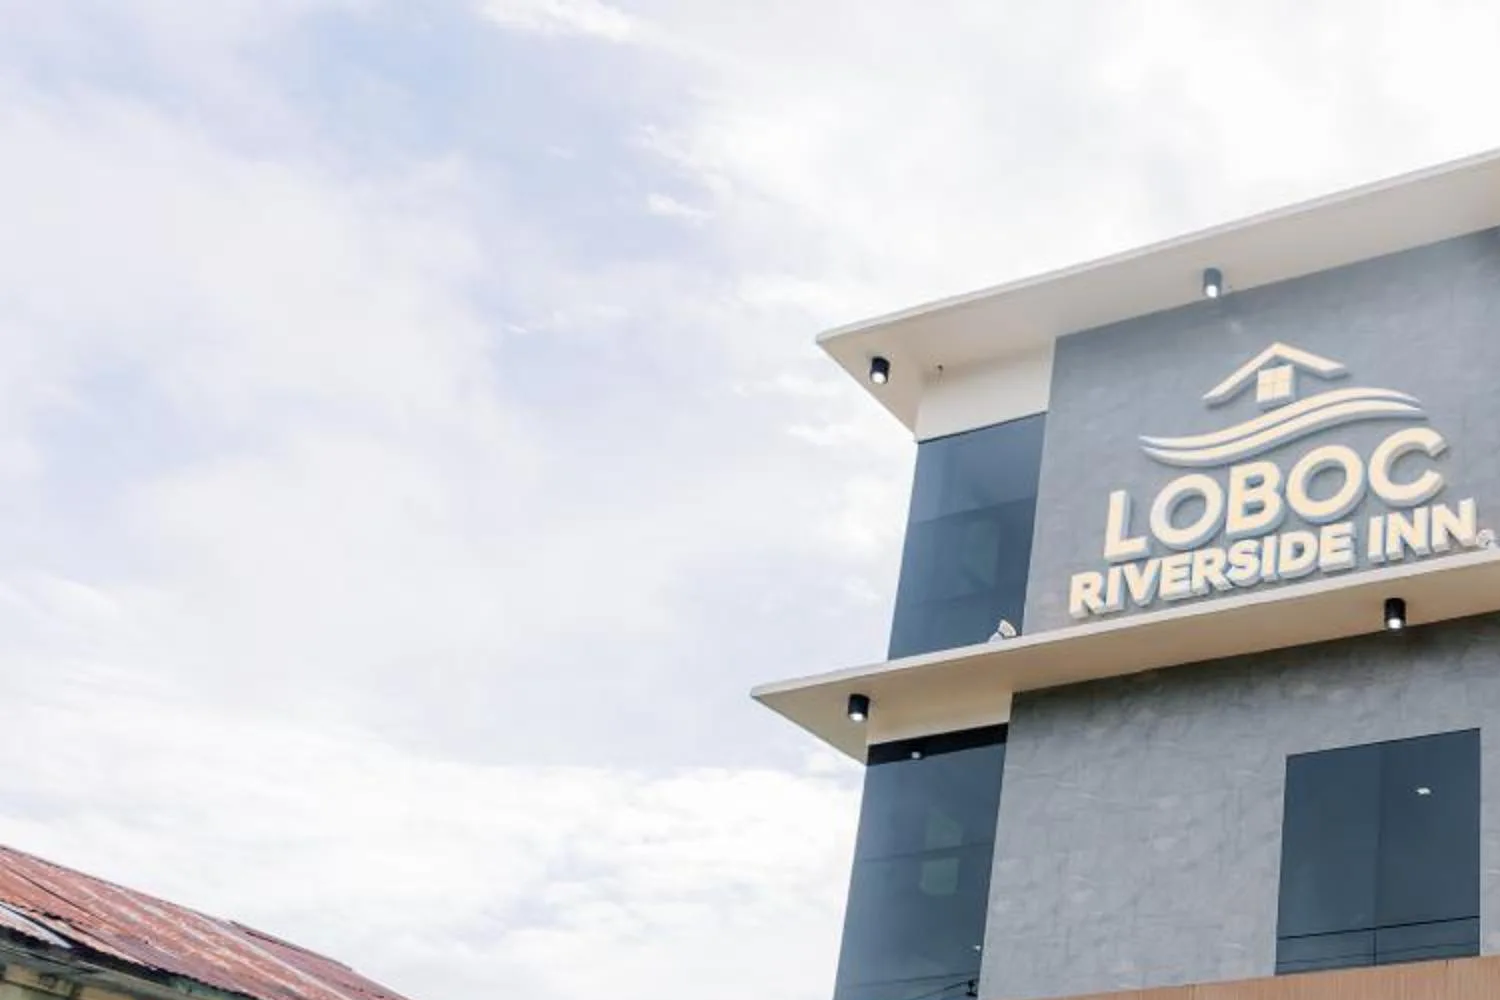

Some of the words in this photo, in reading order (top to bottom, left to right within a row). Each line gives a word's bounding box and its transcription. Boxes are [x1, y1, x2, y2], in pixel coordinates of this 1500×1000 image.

[1068, 521, 1355, 618] RIVERSIDE
[1367, 498, 1478, 562] INN
[1103, 427, 1448, 563] LOBOC
